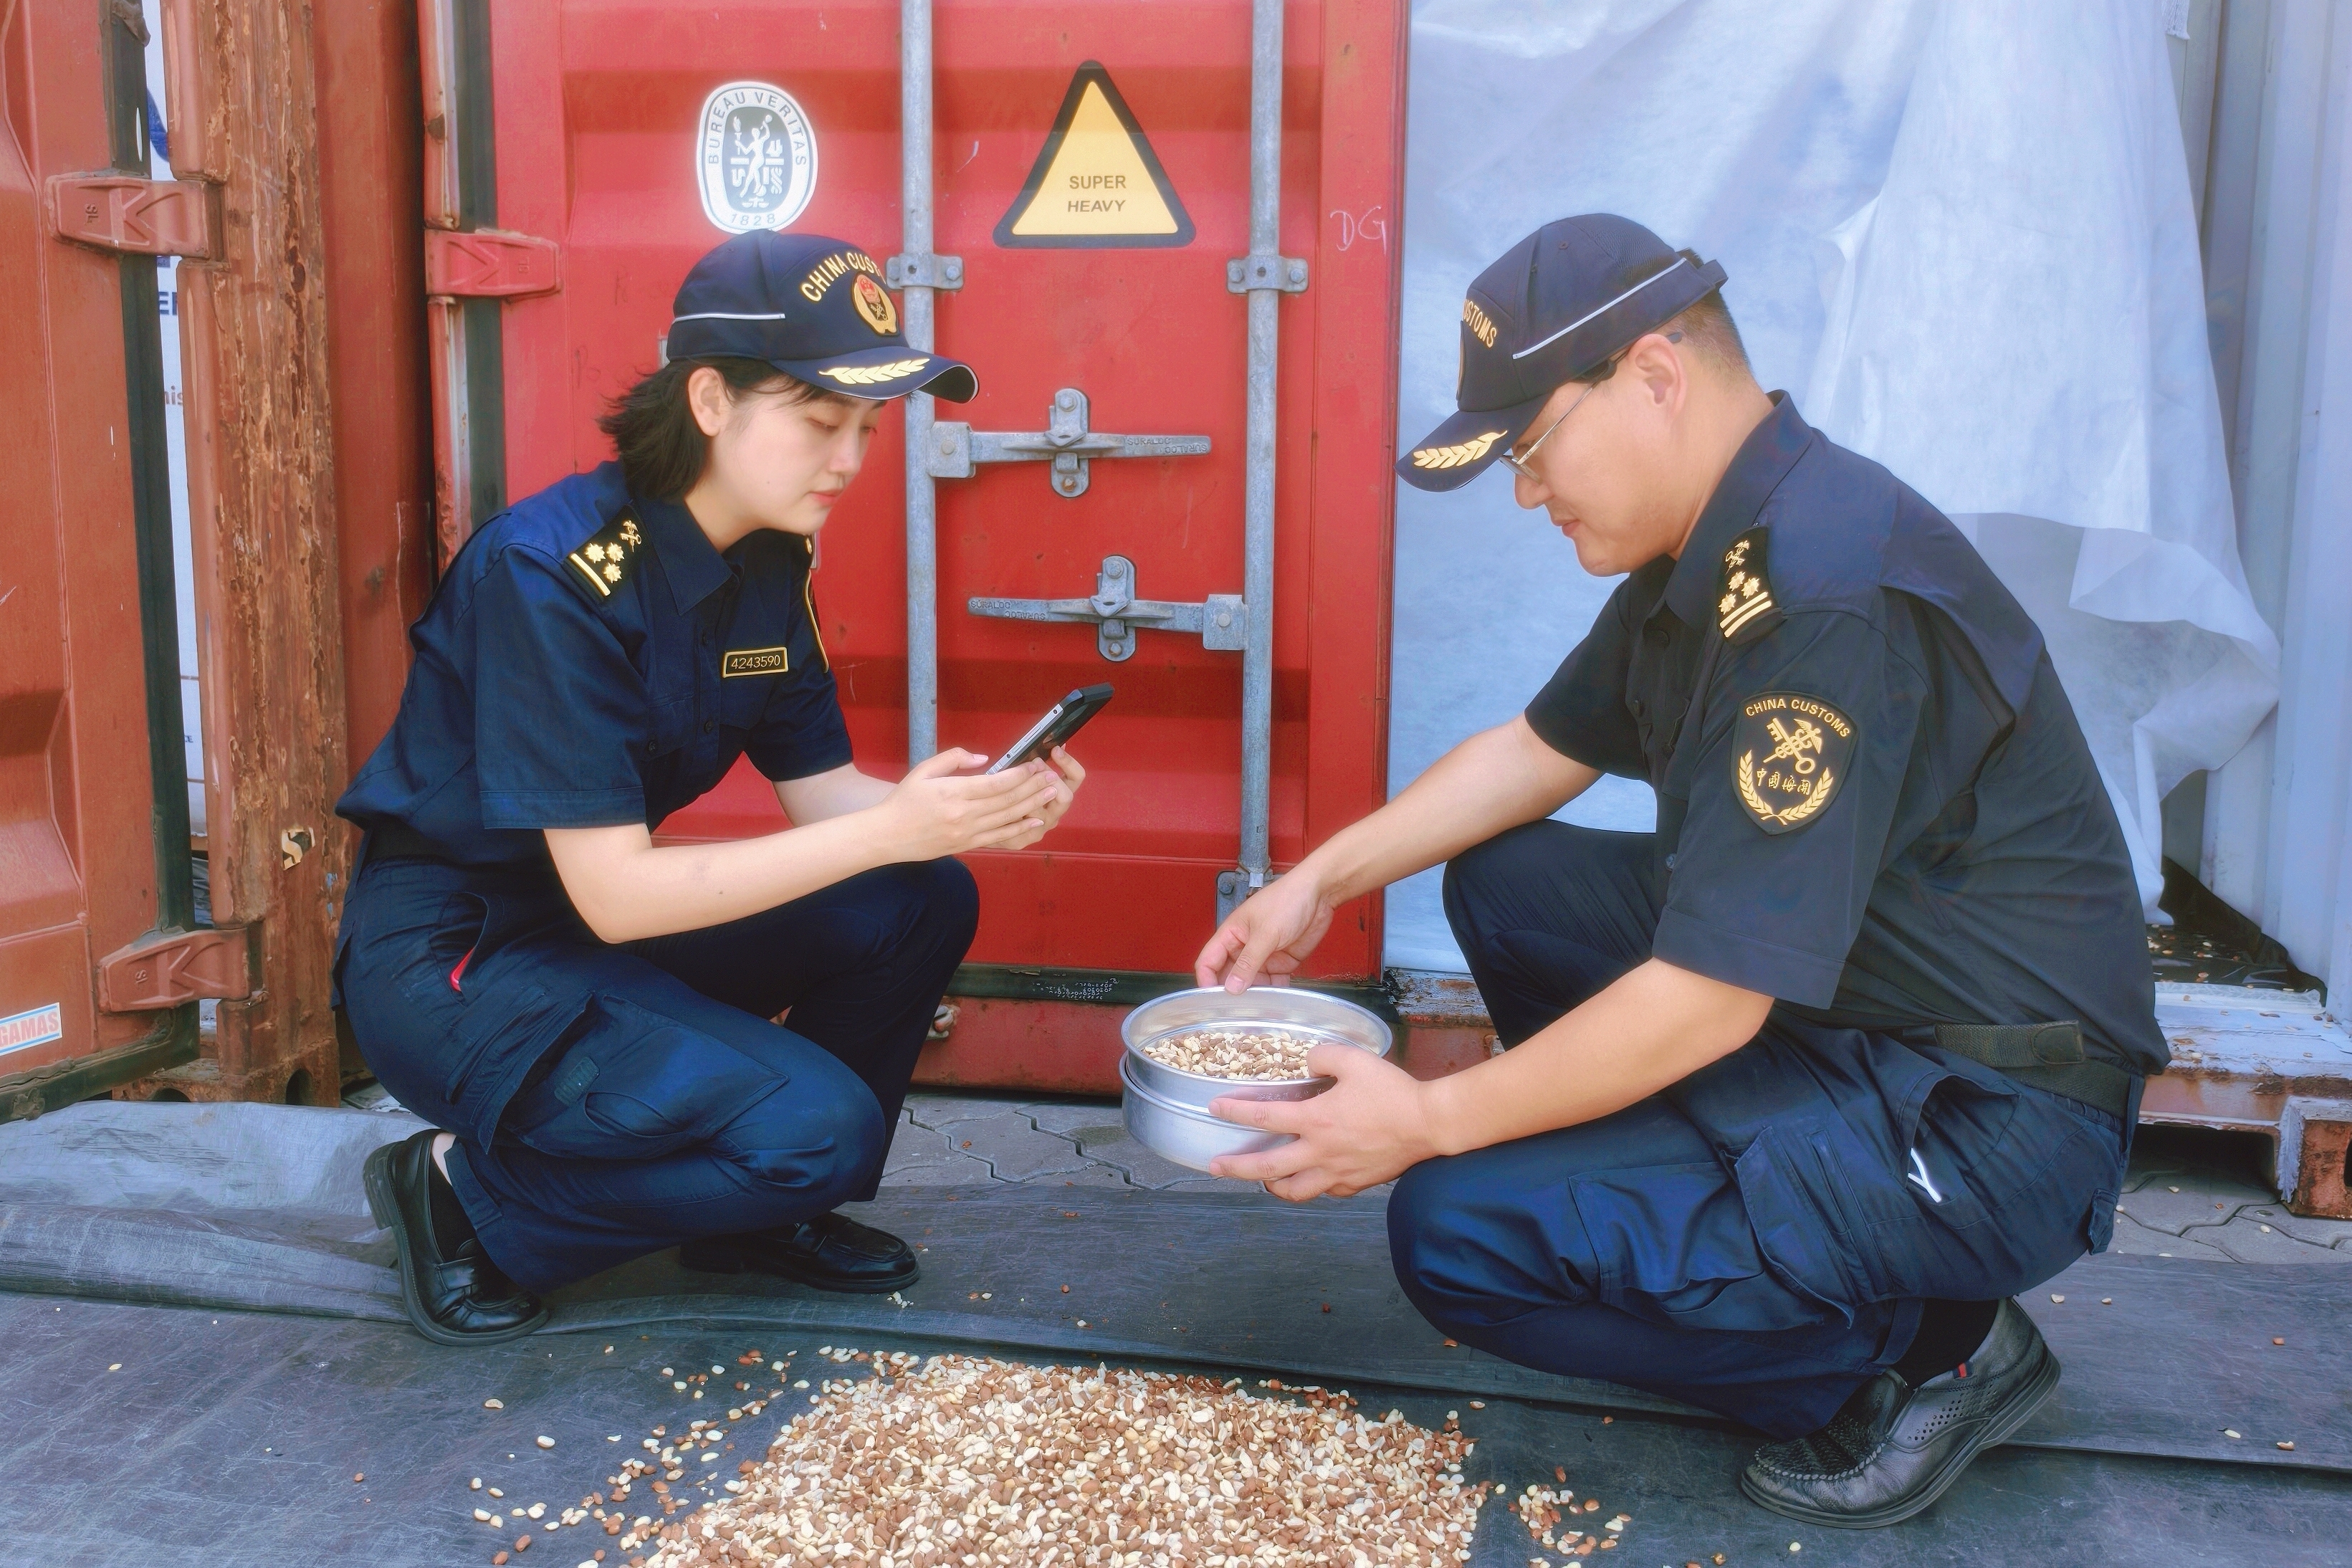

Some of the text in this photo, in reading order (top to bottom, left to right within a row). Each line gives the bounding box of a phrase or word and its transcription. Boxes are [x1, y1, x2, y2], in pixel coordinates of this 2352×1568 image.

[708, 92, 807, 166] BUREAU VERITAS
[1069, 176, 1127, 189] SUPER
[731, 213, 775, 226] 1828
[1068, 200, 1126, 212] HEAVY
[800, 252, 886, 302] CHINA CUST
[1463, 299, 1497, 348] USTOMS
[731, 654, 780, 669] 4243590
[1746, 698, 1851, 737] CHINA CUSTOMS
[0, 1011, 59, 1046] GAMAS
